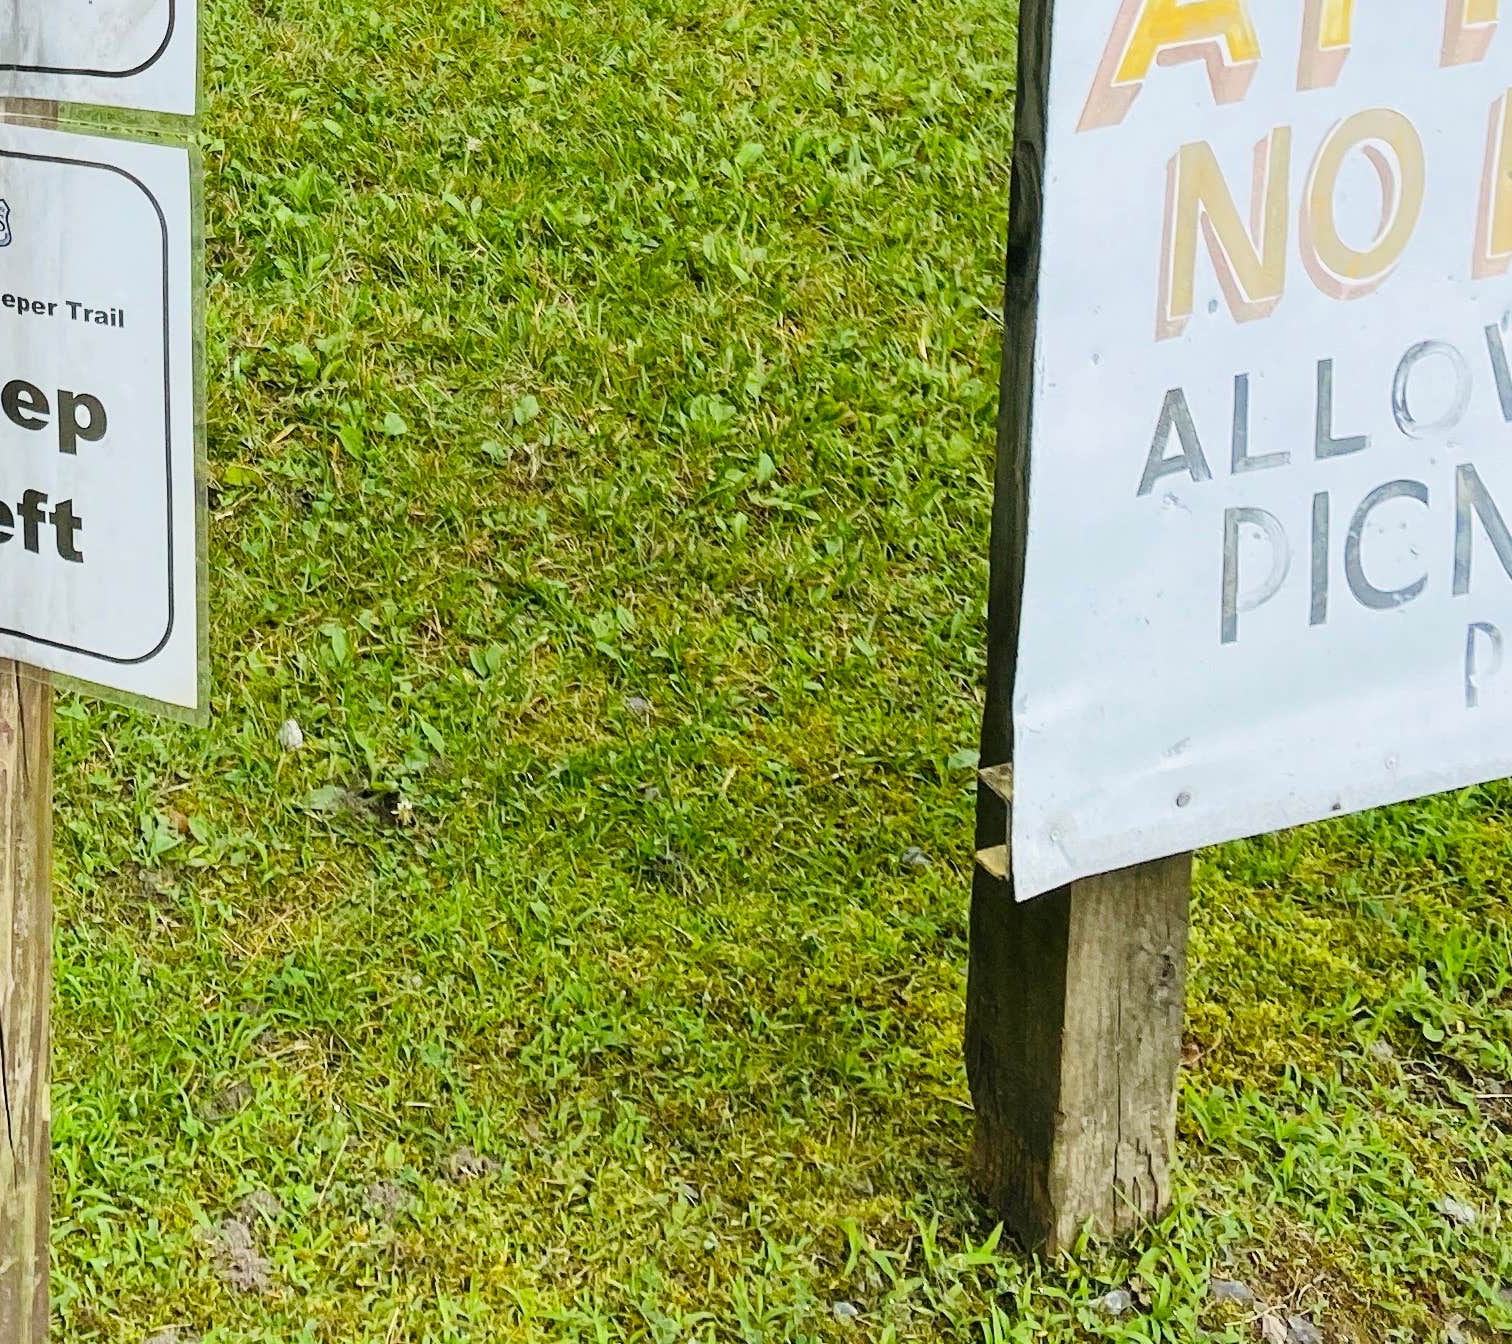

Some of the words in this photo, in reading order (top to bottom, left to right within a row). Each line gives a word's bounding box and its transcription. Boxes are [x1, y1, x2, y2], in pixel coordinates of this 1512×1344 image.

[1154, 106, 1426, 342] NO
[65, 300, 125, 329] Trail
[1136, 322, 1512, 498] ALLO
